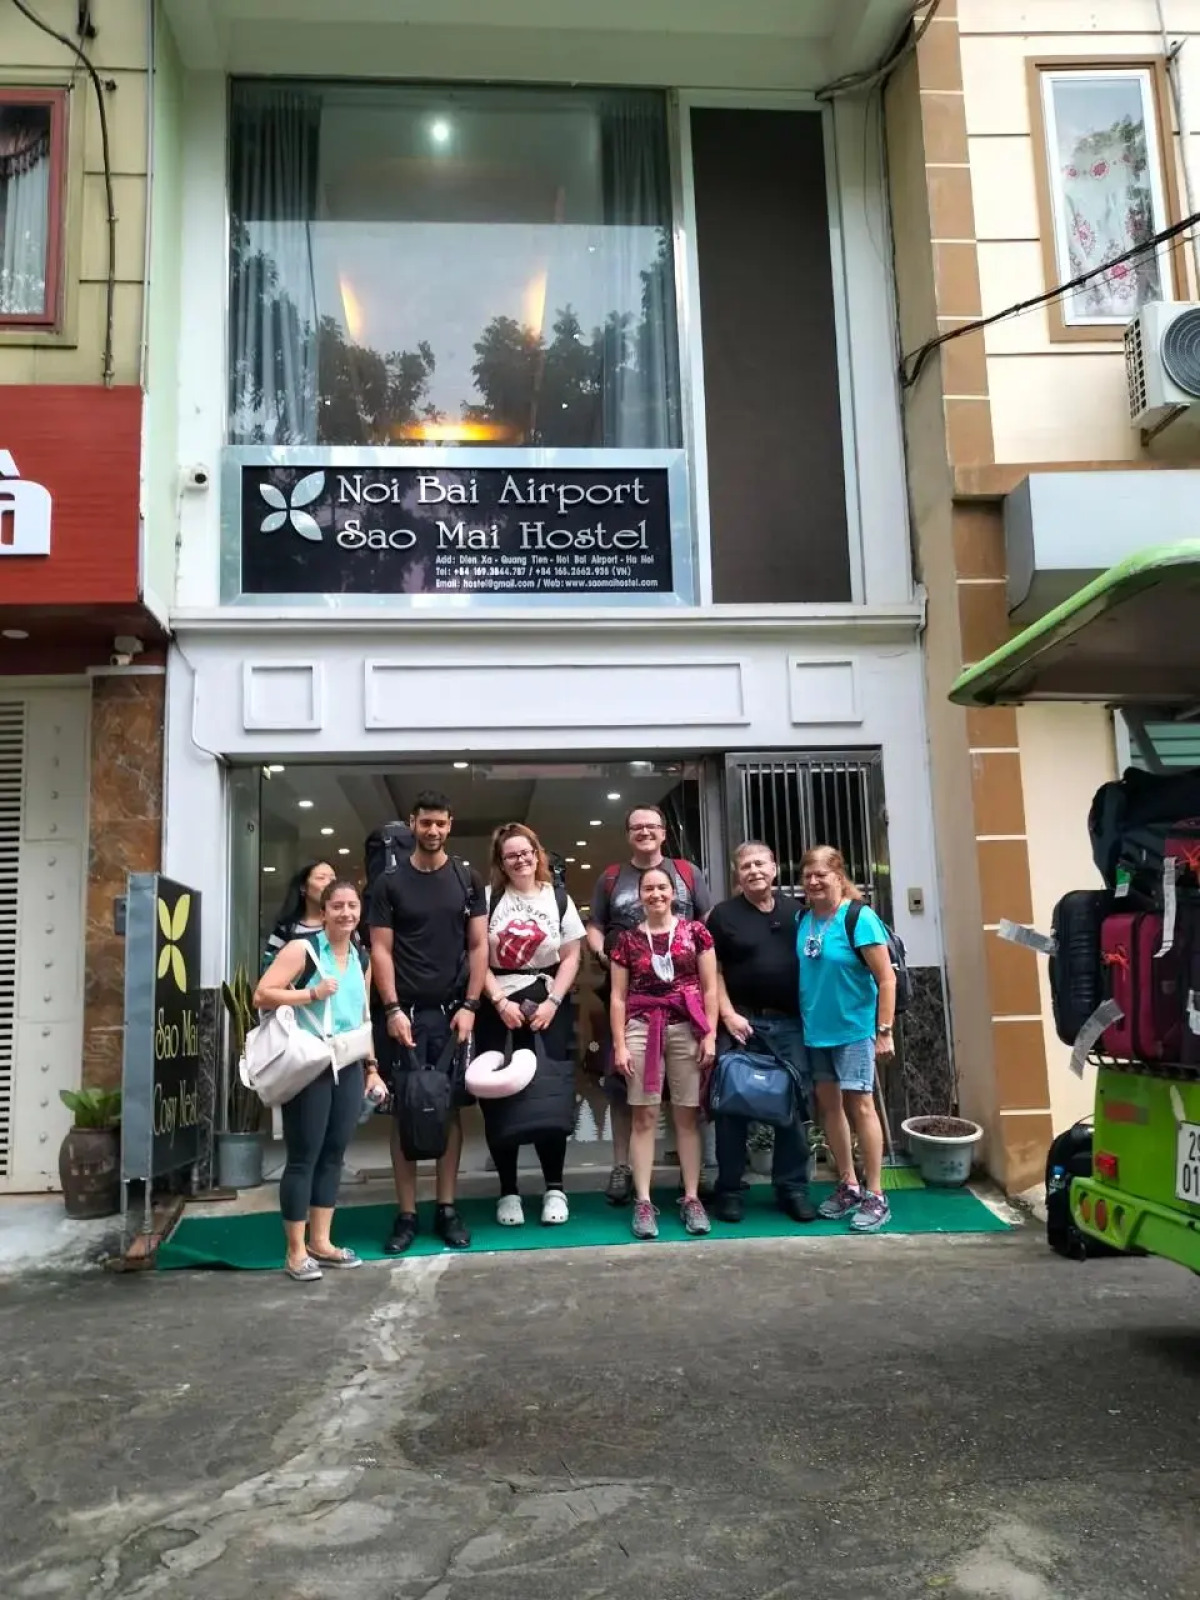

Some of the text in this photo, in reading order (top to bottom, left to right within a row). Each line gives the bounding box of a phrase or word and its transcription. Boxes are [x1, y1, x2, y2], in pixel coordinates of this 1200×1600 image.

[336, 474, 650, 514] Noi Bai Airport
[336, 519, 649, 550] Sao Mai Hostel
[500, 555, 527, 565] Quang
[591, 555, 618, 565] Airport
[155, 1007, 199, 1060] Sao Mai
